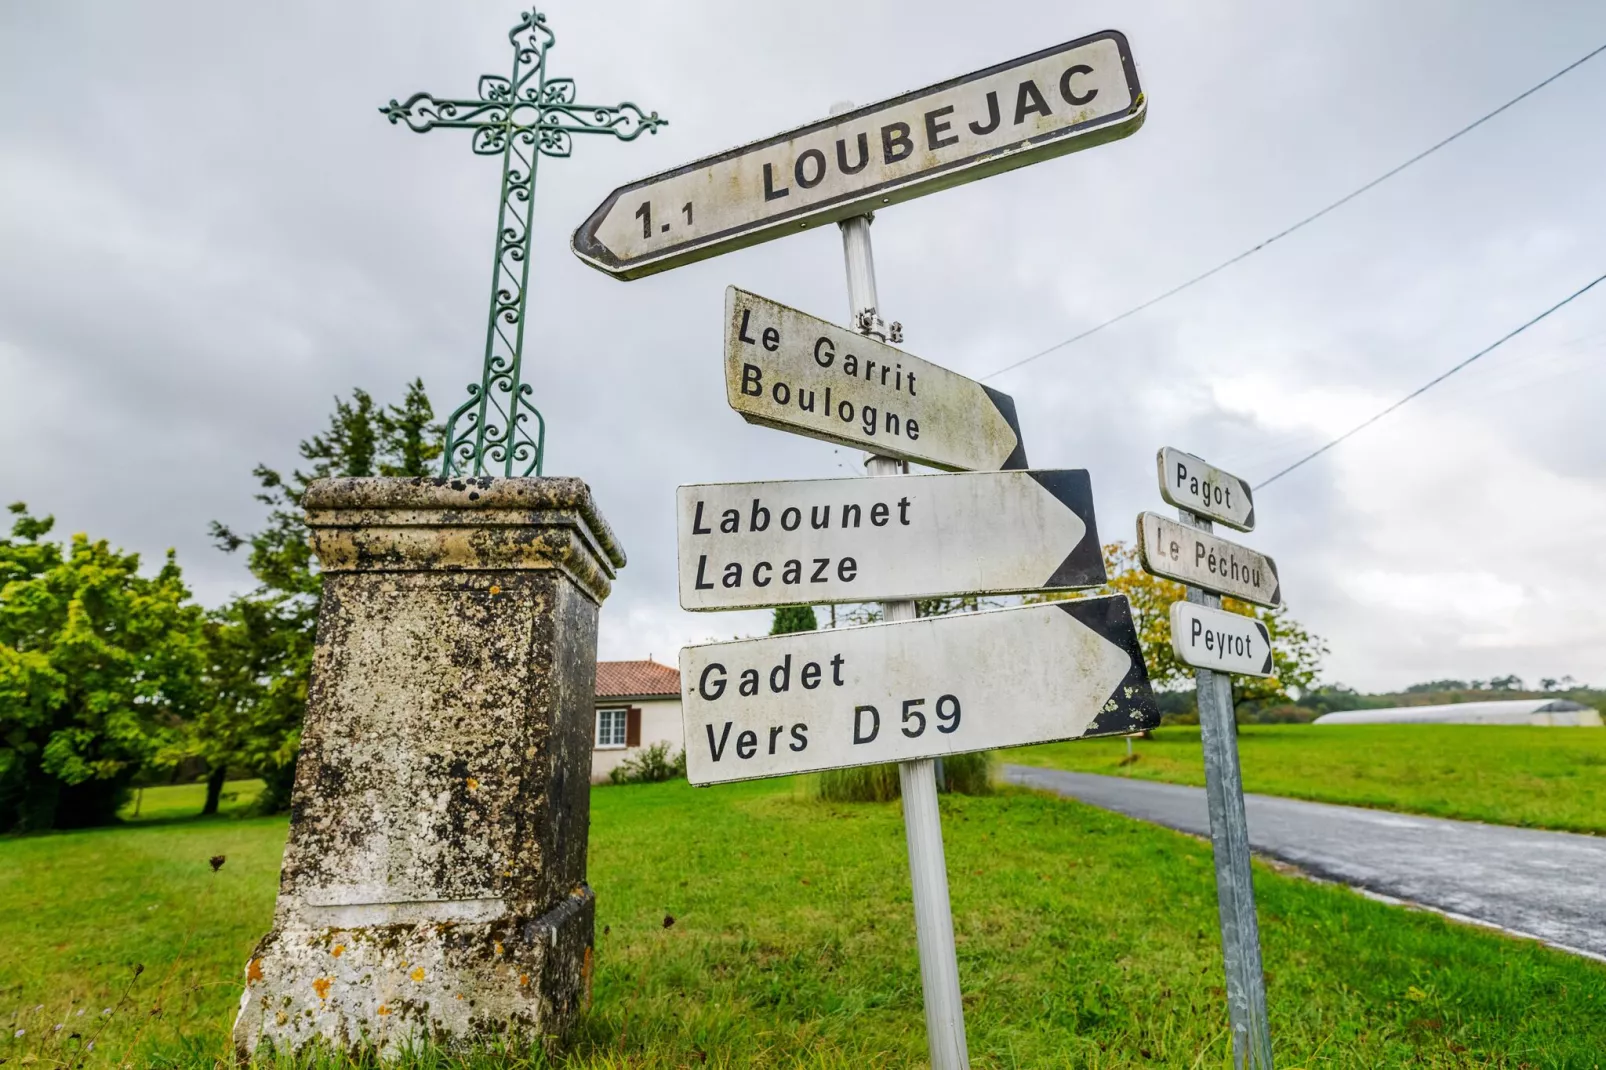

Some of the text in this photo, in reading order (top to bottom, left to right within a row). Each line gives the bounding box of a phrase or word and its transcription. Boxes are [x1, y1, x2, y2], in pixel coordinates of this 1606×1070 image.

[763, 64, 1099, 201] LOUBEJAC
[738, 309, 916, 396] Le Garrit
[741, 363, 920, 441] Boulogne
[1177, 462, 1231, 509] Pagot
[692, 496, 911, 535] Labounet
[695, 554, 858, 590] Lacaze
[1157, 527, 1260, 588] Le Péchou
[1191, 618, 1252, 659] Peyrot
[699, 653, 845, 701] Gadet
[706, 694, 962, 763] Vers D 59
